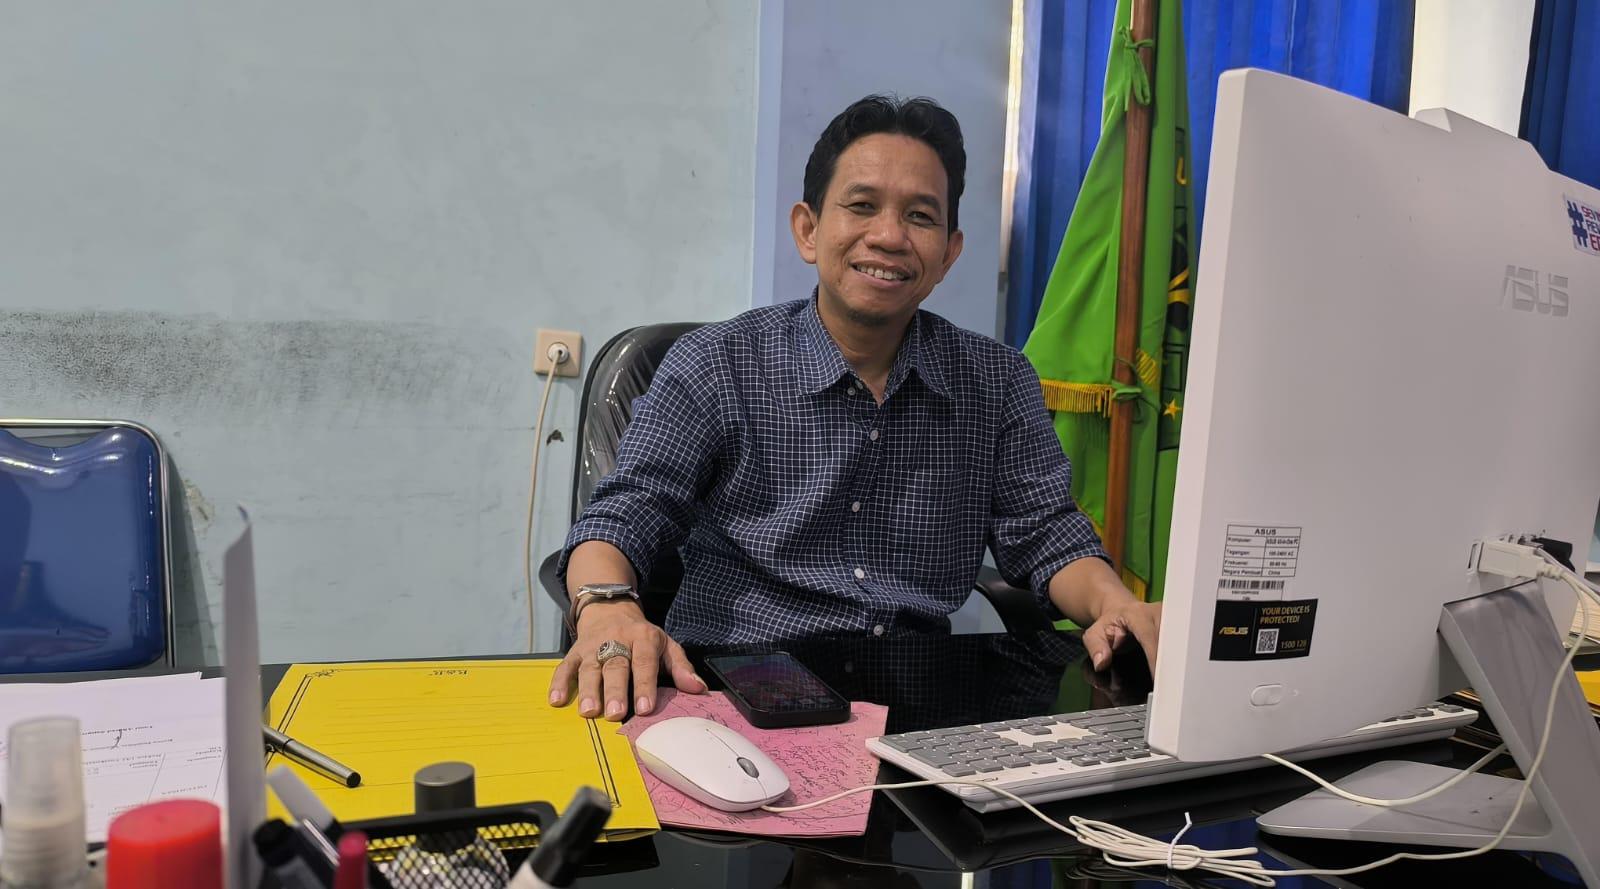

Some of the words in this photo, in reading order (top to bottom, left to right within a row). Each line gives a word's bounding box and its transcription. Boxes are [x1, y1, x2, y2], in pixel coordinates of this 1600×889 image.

[1500, 264, 1569, 317] ASUS
[1255, 528, 1276, 536] ASUS
[1262, 607, 1281, 615] YOUR
[1281, 606, 1303, 614] DEVICE
[1304, 605, 1310, 613] IS
[1219, 627, 1248, 635] ASUS
